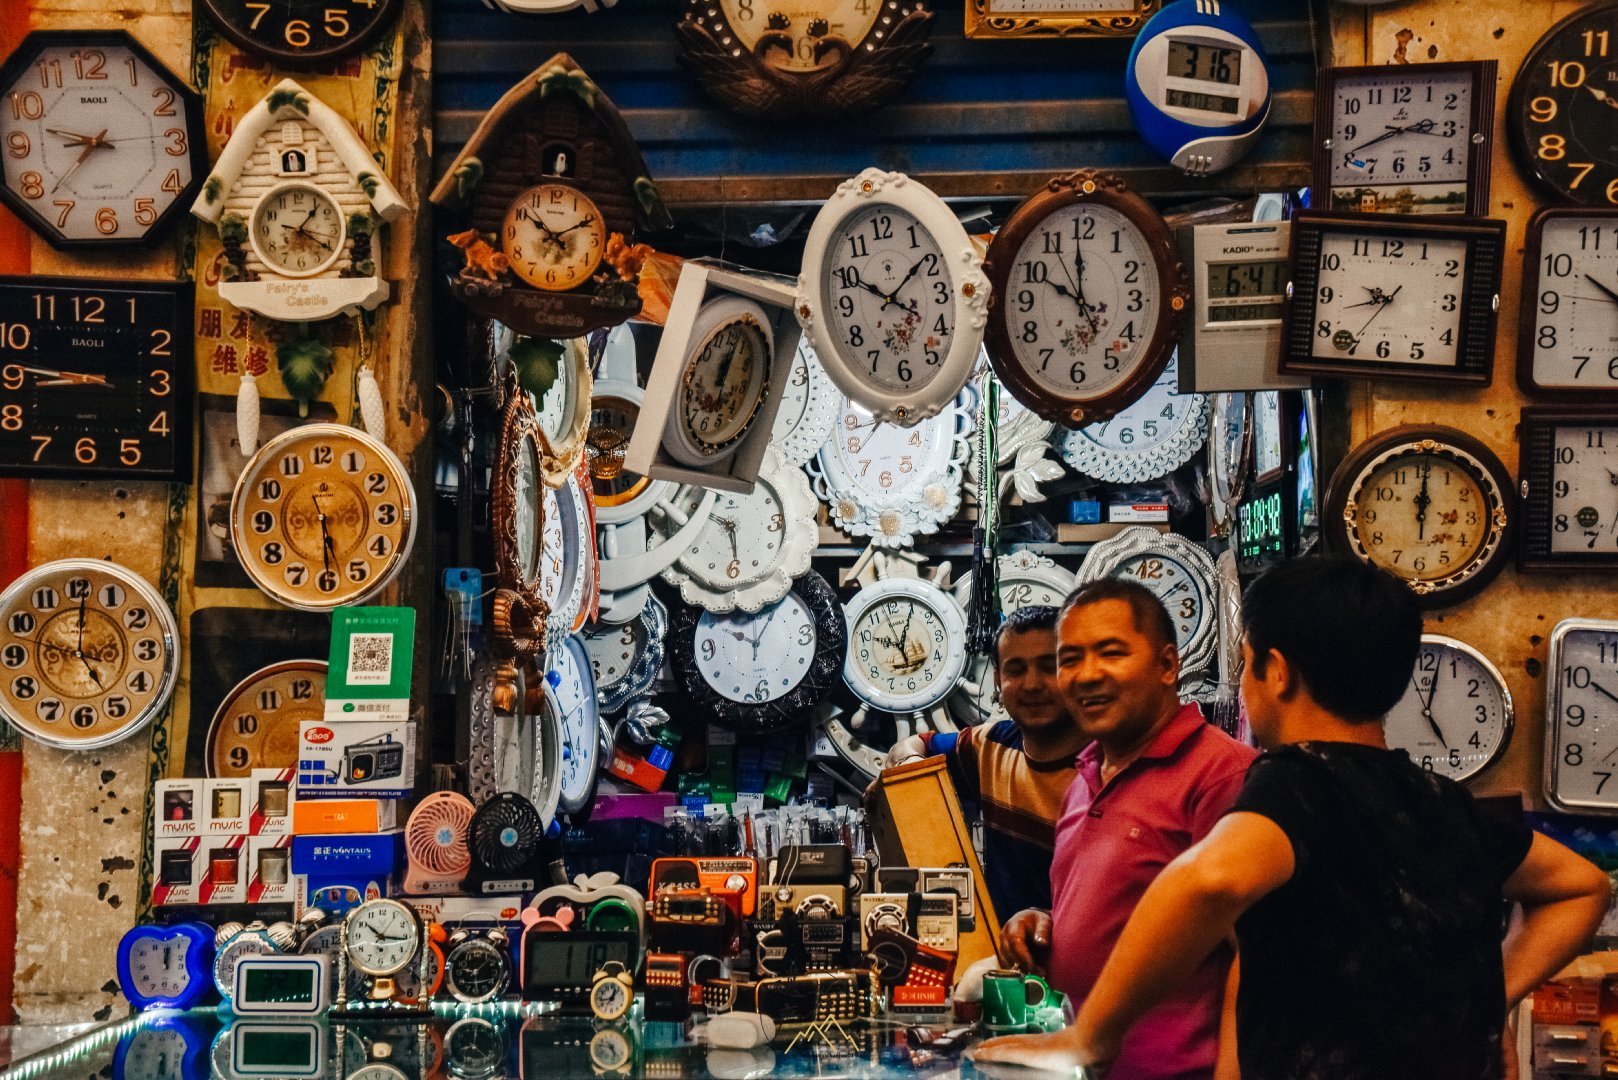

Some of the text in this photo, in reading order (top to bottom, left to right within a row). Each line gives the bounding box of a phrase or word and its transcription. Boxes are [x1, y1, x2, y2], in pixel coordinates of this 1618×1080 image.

[245, 4, 270, 30] 7
[739, 0, 753, 21] 8
[285, 20, 310, 47] 6
[325, 10, 349, 36] 5
[1582, 31, 1608, 56] 11
[38, 59, 62, 88] 11
[74, 51, 108, 80] 12
[125, 57, 137, 86] 1
[1548, 61, 1585, 88] 10
[154, 88, 176, 117] 2
[1368, 90, 1382, 104] 11
[1393, 87, 1411, 103] 12
[1425, 87, 1432, 102] 1
[11, 93, 44, 120] 10
[1530, 97, 1557, 123] 9
[7, 131, 30, 158] 9
[165, 129, 186, 155] 3
[1538, 135, 1566, 160] 8
[21, 172, 43, 200] 8
[162, 169, 182, 196] 4
[1568, 163, 1594, 189] 7
[53, 200, 75, 227] 7
[95, 207, 117, 234] 6
[135, 199, 156, 225] 5
[507, 226, 516, 239] 9
[870, 216, 894, 240] 12
[907, 226, 920, 248] 1
[1072, 217, 1095, 240] 12
[1579, 227, 1601, 250] 11
[513, 246, 522, 259] 8
[848, 235, 868, 258] 11
[1042, 232, 1063, 254] 11
[1111, 231, 1122, 253] 1
[1352, 240, 1369, 256] 11
[1382, 241, 1403, 257] 12
[1421, 244, 1428, 259] 1
[528, 262, 536, 276] 7
[924, 254, 940, 276] 2
[1022, 261, 1047, 283] 10
[1124, 261, 1139, 282] 2
[1544, 254, 1572, 277] 10
[837, 267, 860, 289] 10
[1226, 265, 1280, 296] 6:41
[286, 296, 328, 306] Castle
[934, 282, 948, 304] 3
[1018, 290, 1034, 312] 9
[1128, 290, 1142, 311] 3
[1540, 291, 1559, 314] 9
[32, 294, 55, 320] 11
[71, 298, 104, 322] 12
[126, 299, 135, 322] 1
[839, 296, 854, 317] 9
[933, 314, 948, 336] 4
[1022, 321, 1038, 342] 8
[1119, 321, 1135, 342] 4
[72, 338, 104, 347] BAOLI
[151, 330, 171, 355] 2
[849, 325, 863, 347] 8
[1538, 326, 1557, 349] 8
[213, 345, 269, 376] 维修
[867, 350, 881, 372] 7
[924, 344, 939, 364] 5
[1039, 349, 1054, 370] 7
[1104, 348, 1120, 369] 5
[898, 360, 912, 380] 6
[1070, 362, 1086, 383] 6
[1572, 357, 1589, 378] 7
[150, 370, 170, 396] 3
[689, 408, 698, 423] 7
[714, 413, 722, 426] 5
[1160, 403, 1173, 419] 4
[149, 412, 169, 437] 4
[700, 417, 709, 431] 6
[844, 415, 858, 430] 9
[847, 437, 860, 453] 8
[1587, 431, 1603, 448] 11
[120, 440, 141, 465] 5
[314, 447, 331, 465] 12
[1555, 448, 1573, 464] 10
[284, 458, 300, 475] 11
[859, 460, 872, 476] 7
[1394, 471, 1406, 485] 11
[1443, 471, 1450, 485] 1
[261, 480, 281, 499] 10
[1376, 488, 1393, 501] 10
[1555, 482, 1569, 498] 9
[255, 512, 271, 532] 9
[768, 514, 782, 532] 3
[265, 543, 282, 563] 8
[287, 566, 304, 585] 7
[1136, 560, 1163, 578] 12
[36, 590, 55, 609] 11
[68, 581, 89, 599] 12
[1004, 584, 1032, 603] 12
[886, 601, 899, 614] 12
[12, 616, 34, 634] 10
[868, 612, 880, 625] 11
[859, 630, 872, 643] 10
[702, 638, 716, 661] 9
[1449, 661, 1457, 678] 1
[1564, 667, 1590, 688] 10
[292, 680, 311, 699] 12
[1468, 680, 1479, 697] 2
[358, 704, 390, 712] 微信支付
[1475, 705, 1487, 723] 3
[1566, 705, 1585, 727] 9
[1469, 732, 1480, 749] 4
[1449, 749, 1460, 767] 5
[1564, 744, 1583, 766] 8
[1593, 772, 1611, 794] 7
[163, 823, 195, 832] music
[210, 822, 242, 830] music
[407, 988, 413, 997] 6
